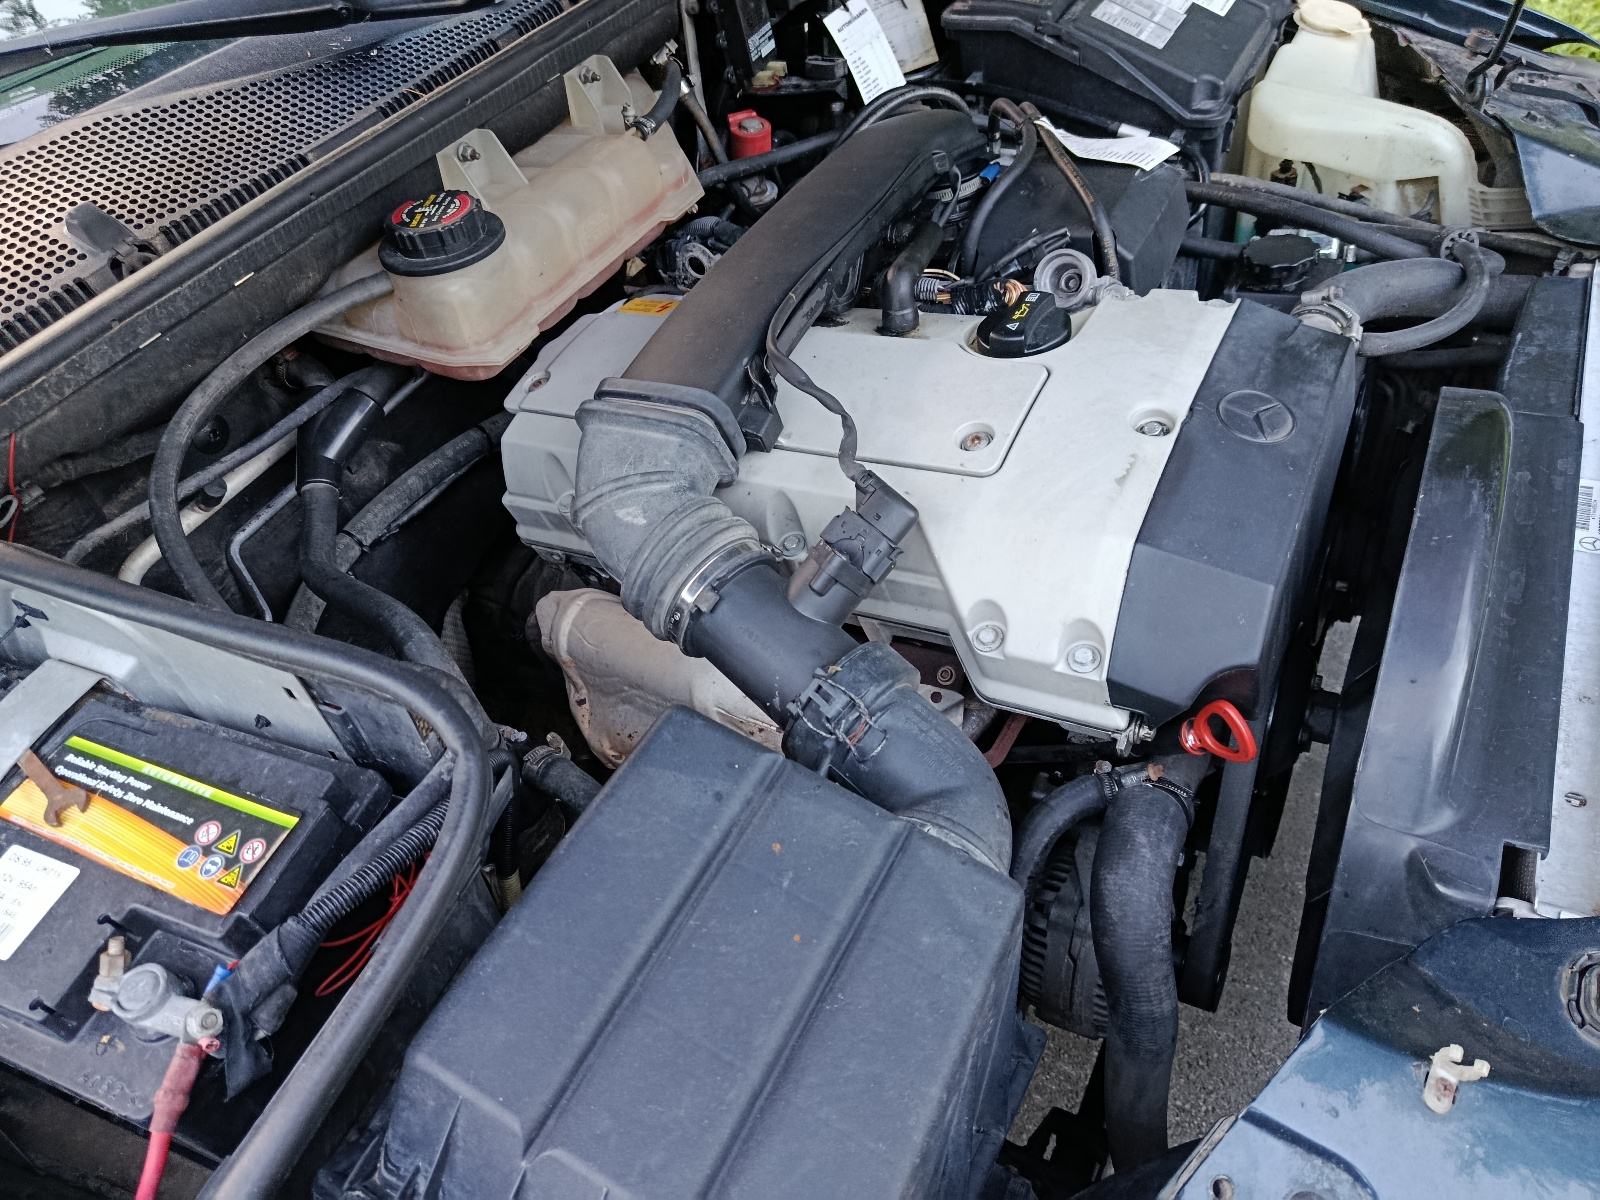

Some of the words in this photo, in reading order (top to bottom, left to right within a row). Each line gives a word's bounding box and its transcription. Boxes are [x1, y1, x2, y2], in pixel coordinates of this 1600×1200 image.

[54, 765, 100, 787] Operational
[123, 792, 145, 806] Zero
[141, 799, 194, 825] Maintenance
[64, 753, 97, 770] Reliable
[94, 764, 128, 783] Starting
[124, 776, 152, 791] Power
